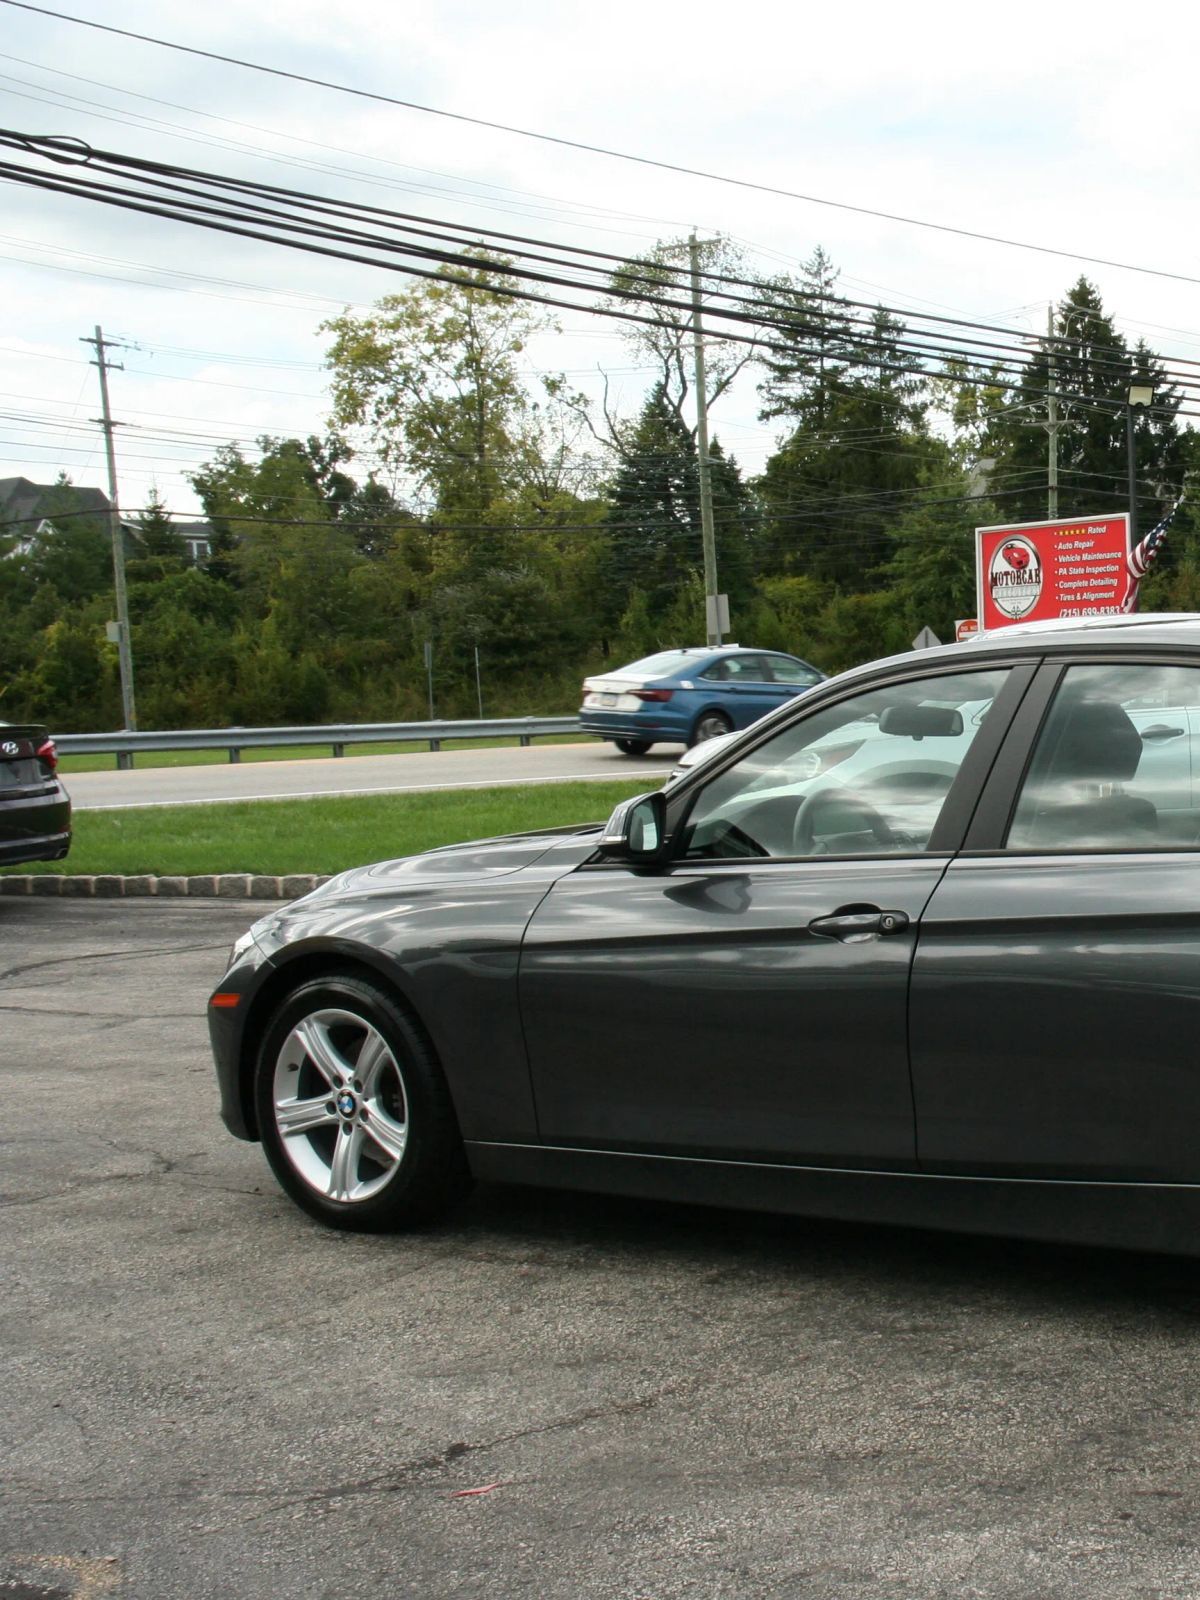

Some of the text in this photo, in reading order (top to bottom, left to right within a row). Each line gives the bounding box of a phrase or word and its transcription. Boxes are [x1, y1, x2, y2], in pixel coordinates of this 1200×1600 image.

[1087, 525, 1107, 535] Rated
[1057, 540, 1095, 550] Auto Repair
[1058, 551, 1122, 563] Vehicle Maintenance
[1058, 564, 1119, 576] PA State Inspection
[990, 568, 1041, 587] MOTORCAR
[1059, 577, 1118, 589] Complete Detailing
[1059, 591, 1115, 602] Tires & Alignment
